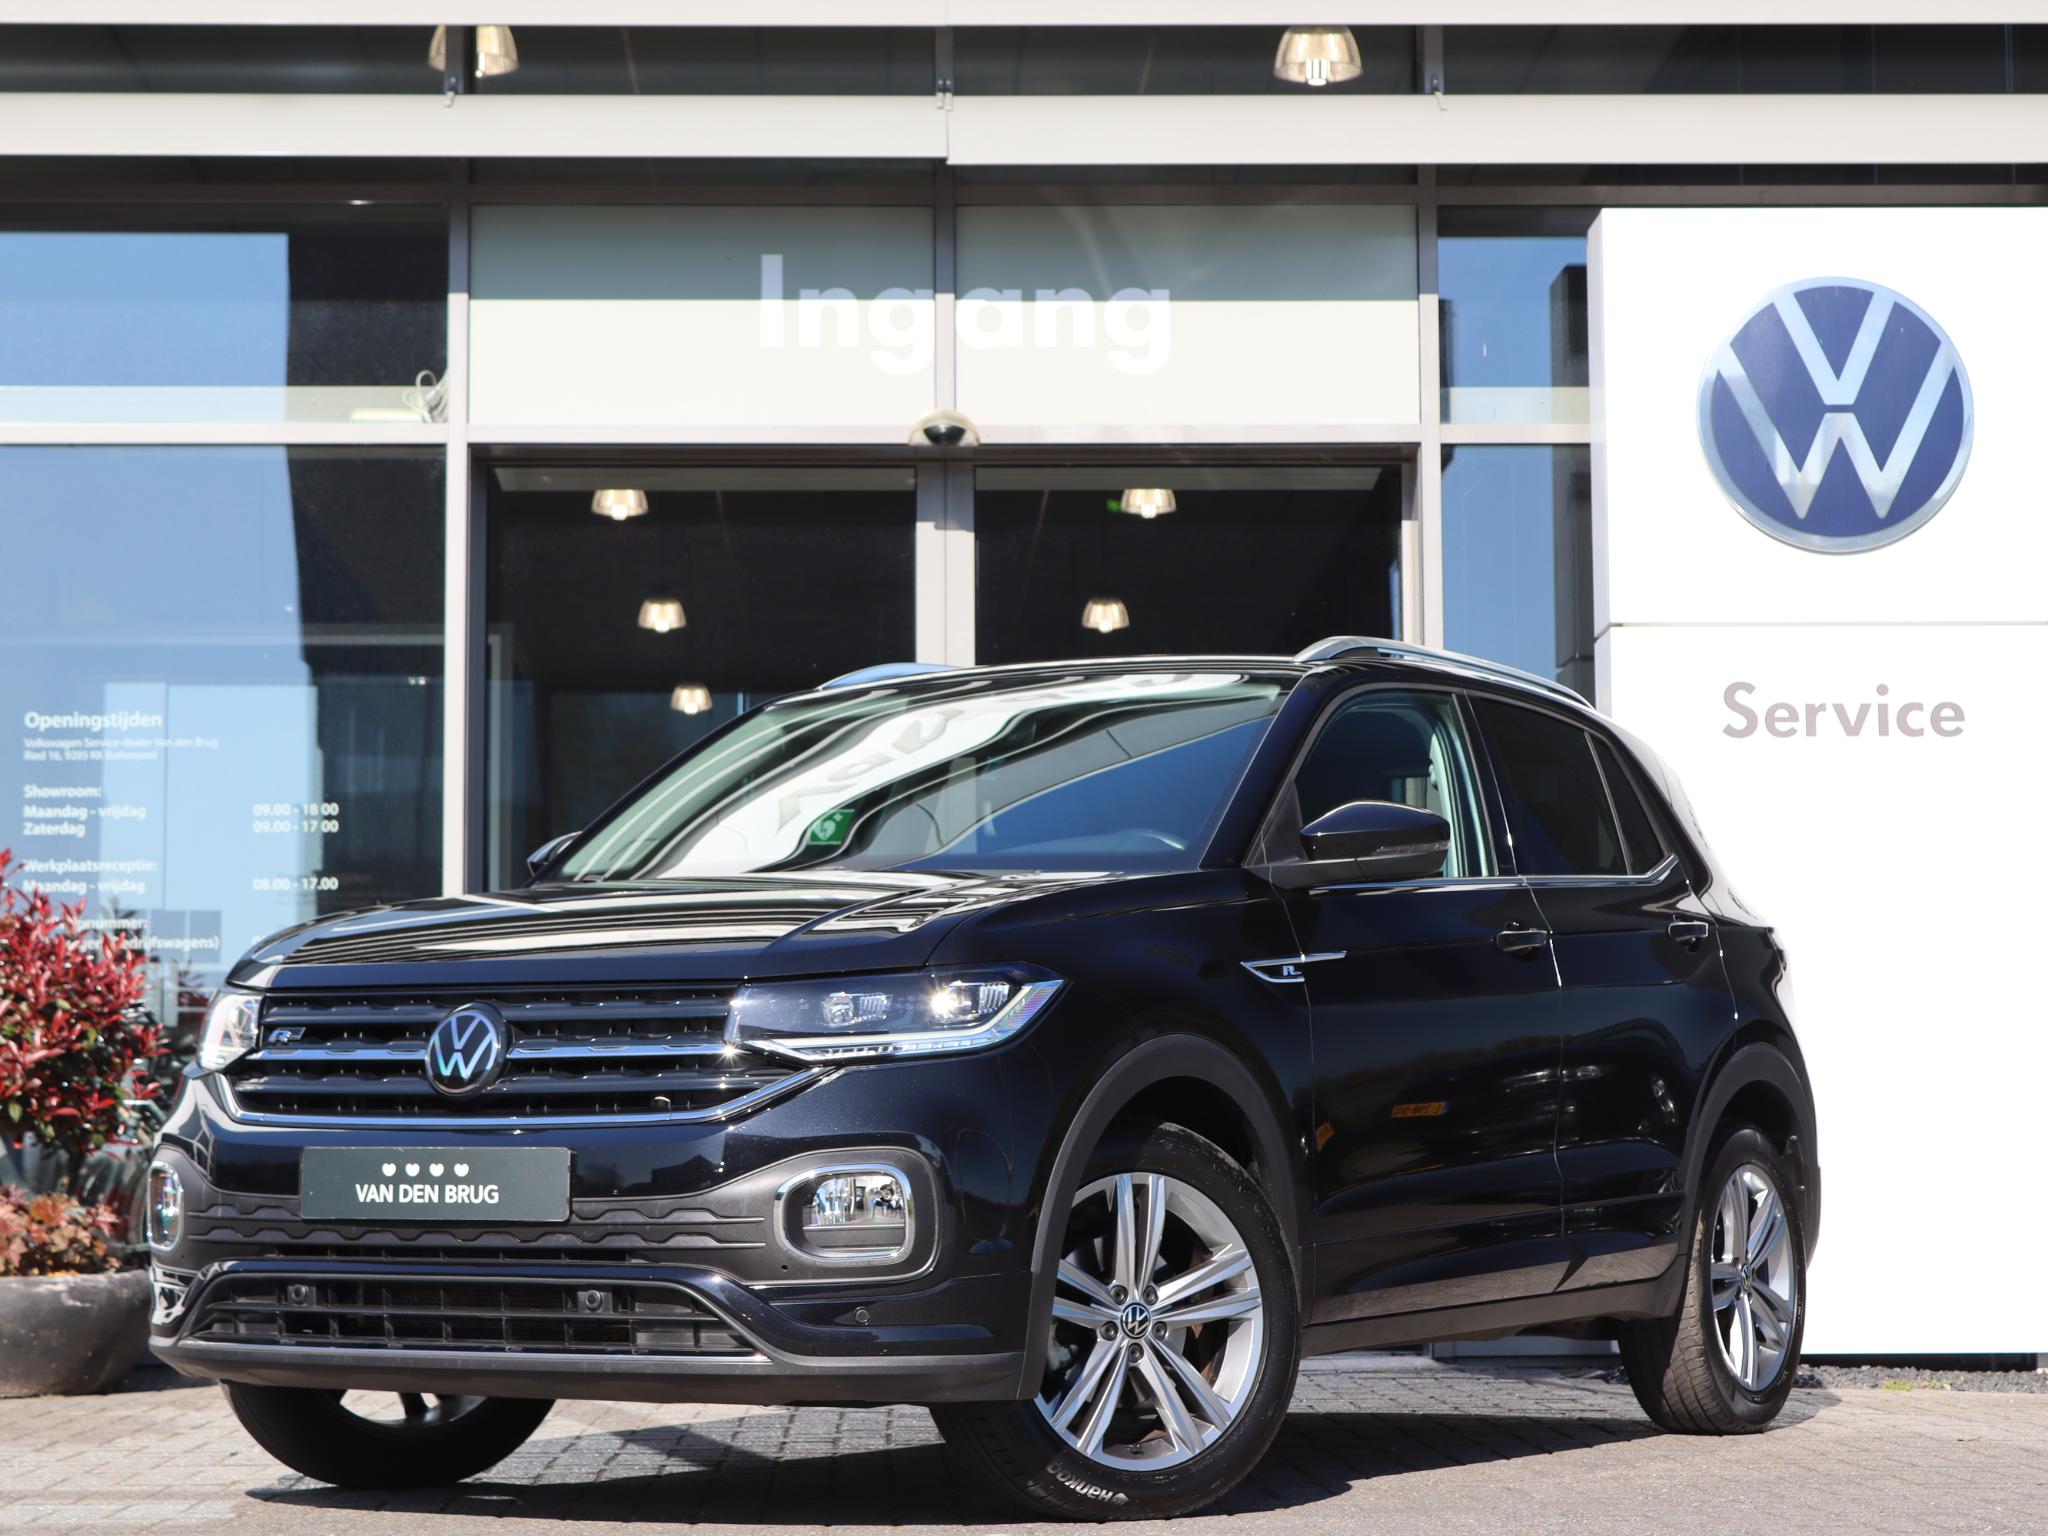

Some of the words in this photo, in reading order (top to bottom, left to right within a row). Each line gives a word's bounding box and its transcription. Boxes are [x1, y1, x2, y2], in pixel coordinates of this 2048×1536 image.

[761, 254, 1171, 376] Ingang
[1722, 681, 1966, 739] Service
[24, 710, 162, 731] Openingstijden
[23, 784, 102, 799] Showroom:
[23, 804, 88, 821] Maandag
[99, 804, 146, 820] vrijdag
[302, 802, 340, 816] 1800
[23, 821, 86, 838] Zaterdag
[302, 819, 340, 833] 1700
[24, 858, 159, 875] Werkplaatsreceptie:
[22, 878, 88, 896] Maandag
[98, 878, 146, 895] vrijdag
[302, 876, 339, 890] 17.00
[355, 1183, 394, 1203] VAN
[398, 1184, 441, 1203] DEN
[444, 1184, 500, 1205] BRUG
[1045, 1462, 1115, 1503] Hankoo
